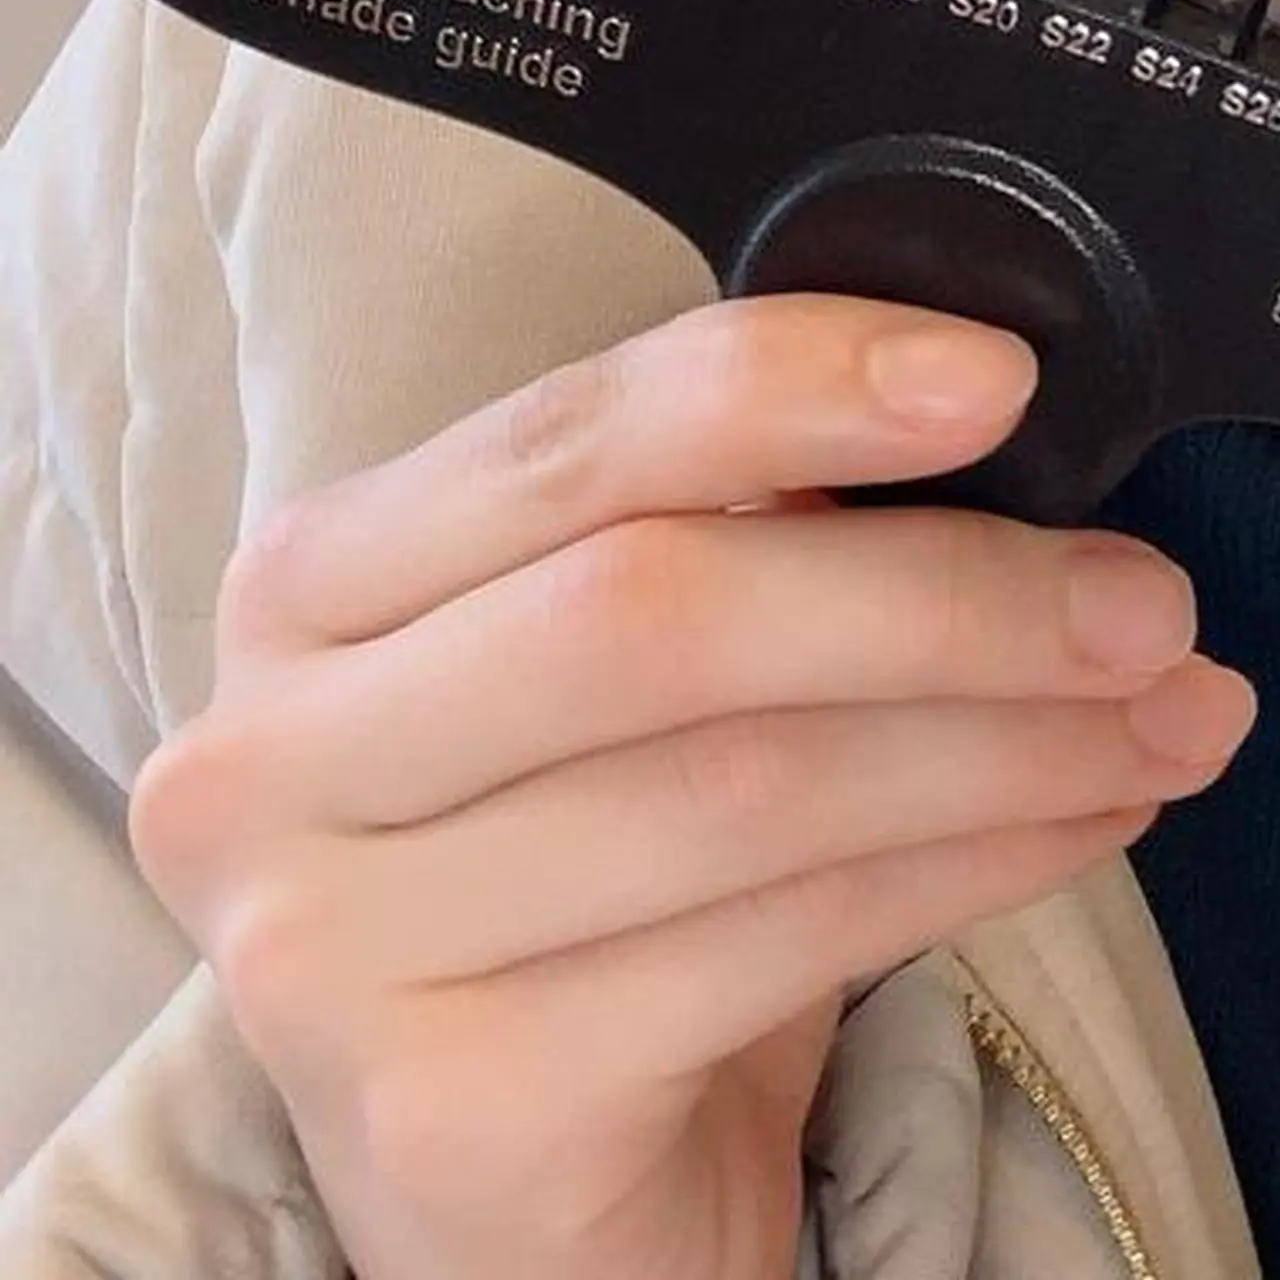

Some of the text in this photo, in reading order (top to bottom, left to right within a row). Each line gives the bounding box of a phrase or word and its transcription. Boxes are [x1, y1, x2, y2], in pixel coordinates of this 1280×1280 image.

[434, 26, 586, 98] guide
[1040, 14, 1112, 62] S22
[1132, 47, 1202, 94] S24
